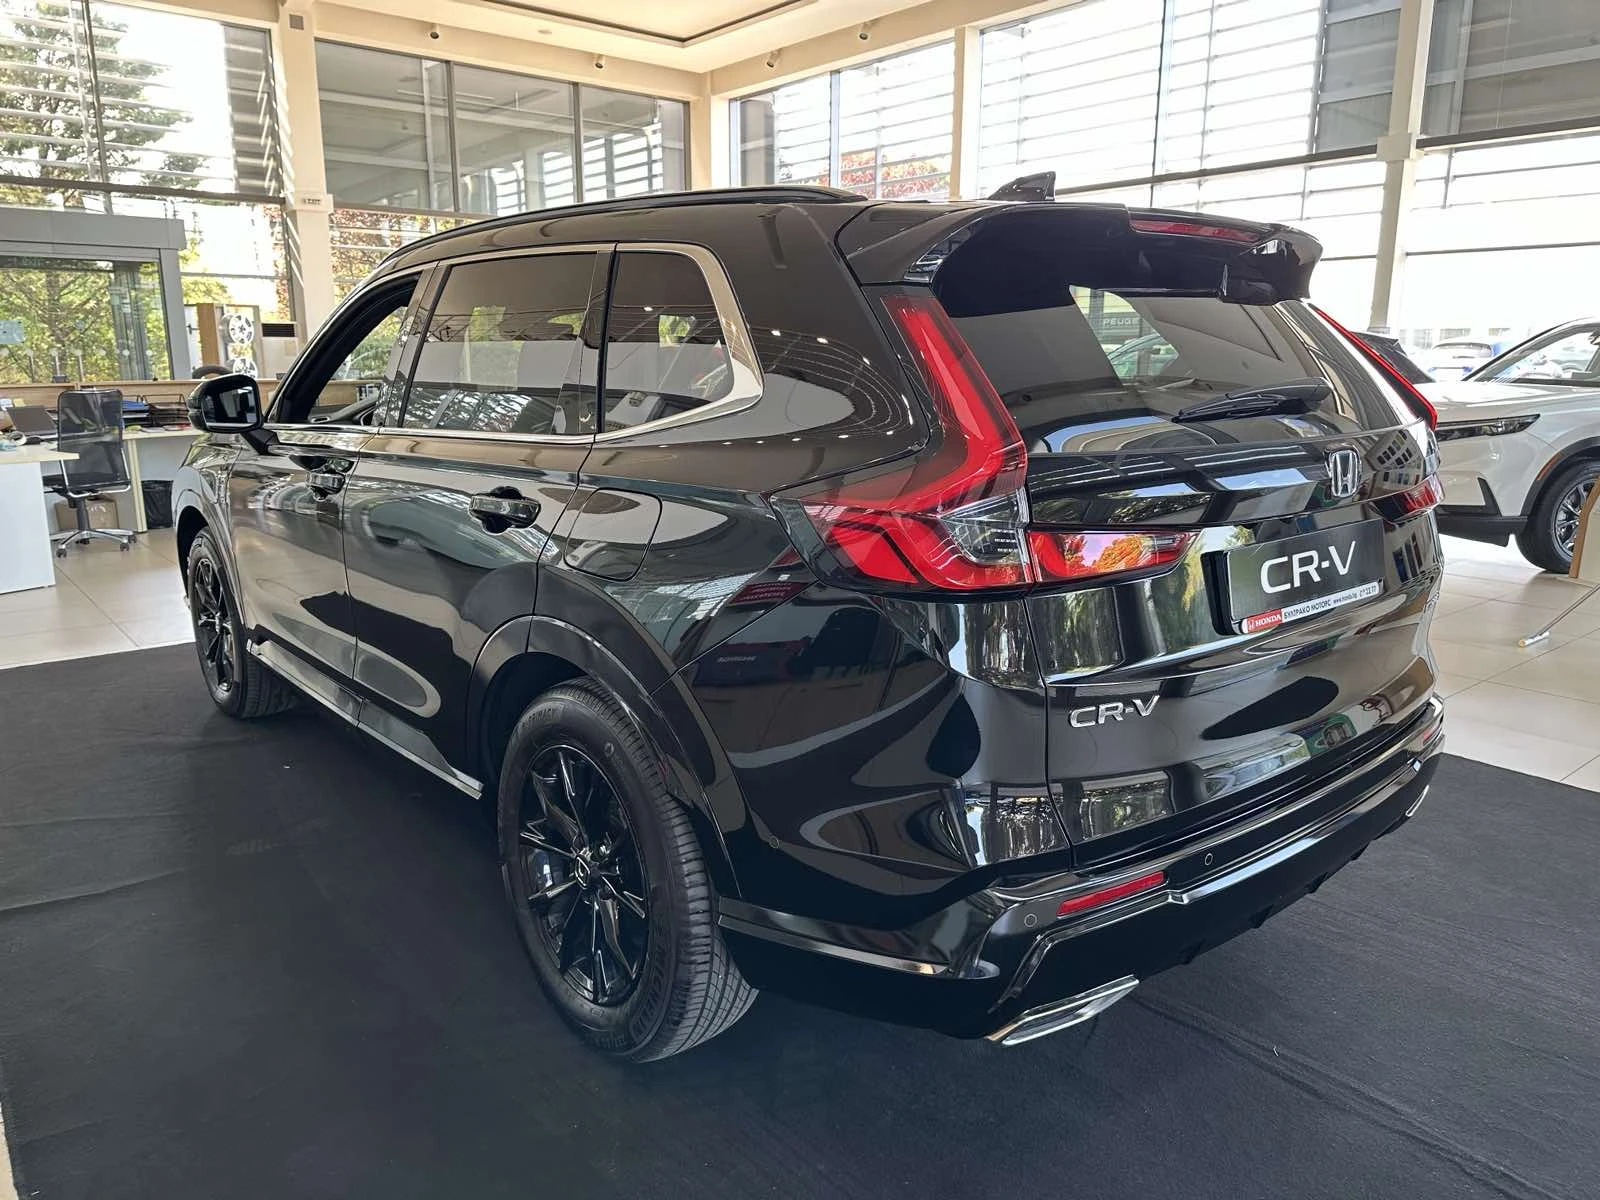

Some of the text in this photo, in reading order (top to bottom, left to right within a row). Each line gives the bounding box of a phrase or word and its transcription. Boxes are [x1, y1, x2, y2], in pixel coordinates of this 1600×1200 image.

[1260, 540, 1356, 594] CR-V
[1255, 613, 1281, 627] HONDA
[1069, 694, 1160, 728] CR-V
